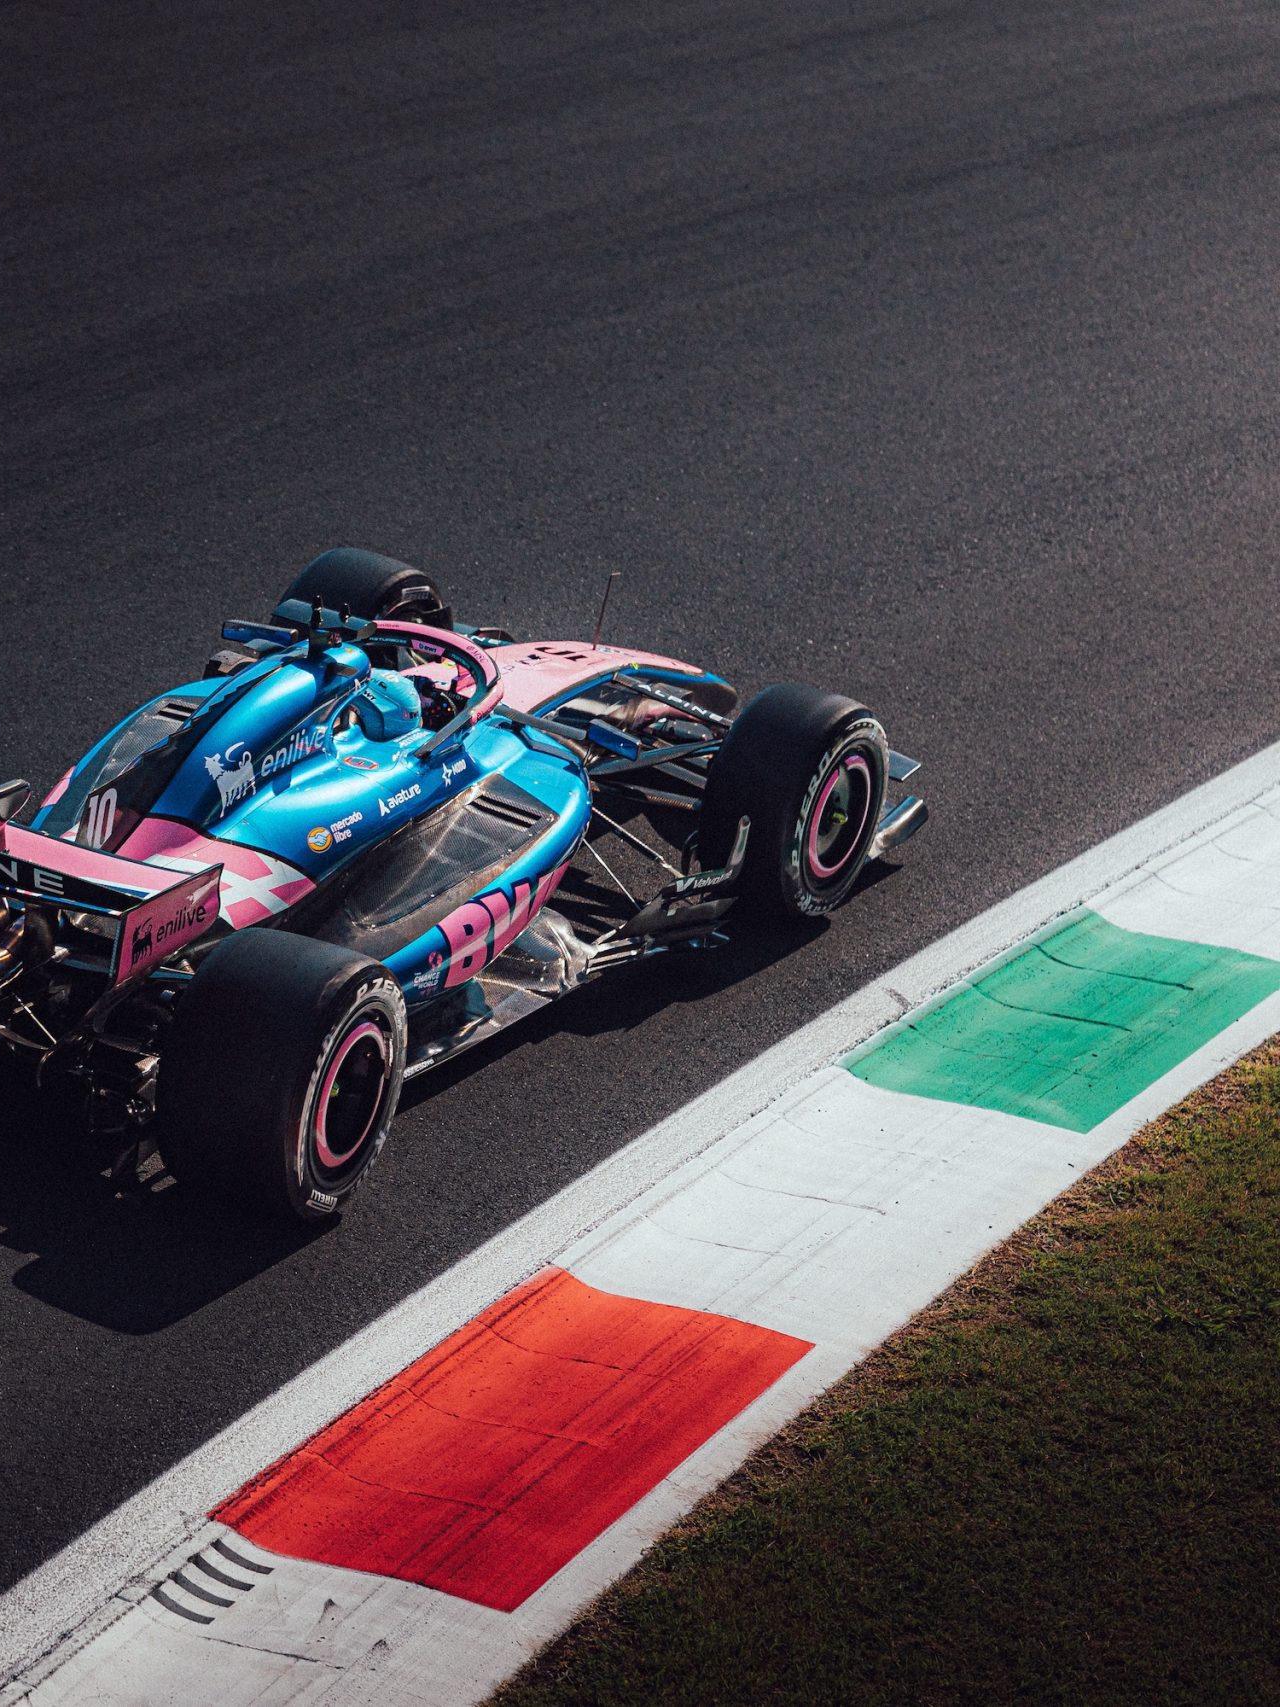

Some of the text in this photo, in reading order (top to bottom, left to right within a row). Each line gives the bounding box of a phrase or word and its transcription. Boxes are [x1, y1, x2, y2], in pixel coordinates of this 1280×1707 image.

[637, 684, 723, 722] ALPINE
[260, 728, 326, 777] enilive
[388, 783, 421, 809] avature
[794, 751, 830, 841] ZERO
[86, 787, 118, 850] 10
[330, 811, 363, 833] mercado
[334, 828, 352, 844] libre
[156, 905, 206, 943] enilive
[438, 860, 571, 989] BW
[305, 1188, 338, 1213] PIRELLI
